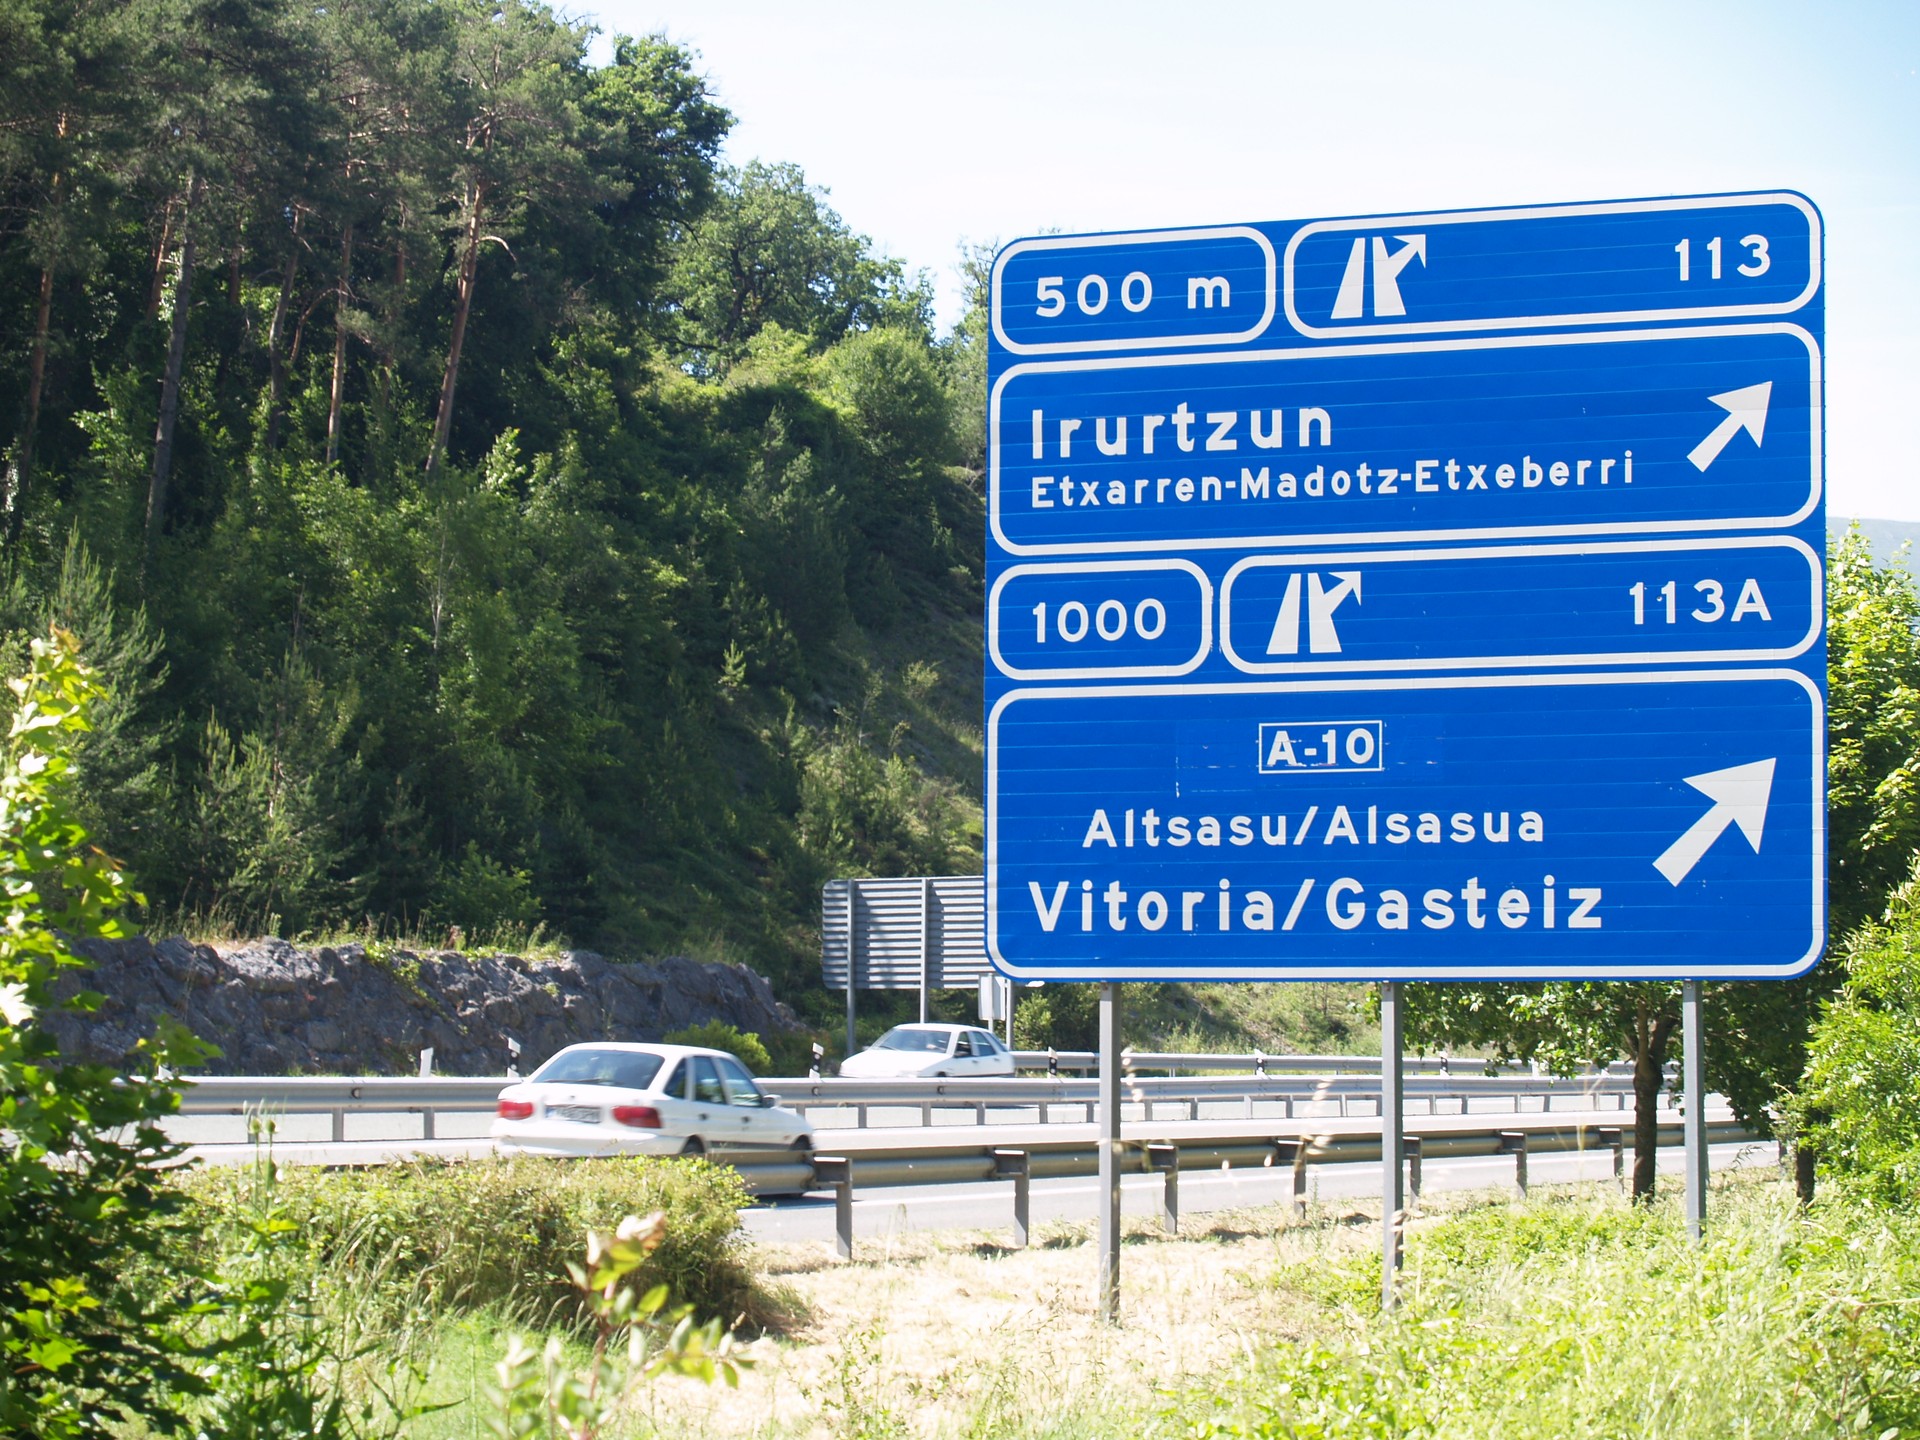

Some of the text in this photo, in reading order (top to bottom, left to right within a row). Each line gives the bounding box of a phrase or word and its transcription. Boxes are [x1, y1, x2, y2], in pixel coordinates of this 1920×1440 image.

[1674, 233, 1771, 281] 113
[1036, 271, 1231, 318] 500 m
[1032, 401, 1332, 460] Irurtzun
[1031, 449, 1633, 508] Etxarren-Madotz-Etxeberri
[1032, 598, 1167, 643] 1000
[1629, 578, 1772, 625] 113A
[1266, 728, 1375, 767] A-10
[1082, 805, 1544, 848] Altsasu/Alsasua
[1028, 874, 1602, 932] Vitoria/Gasteiz
